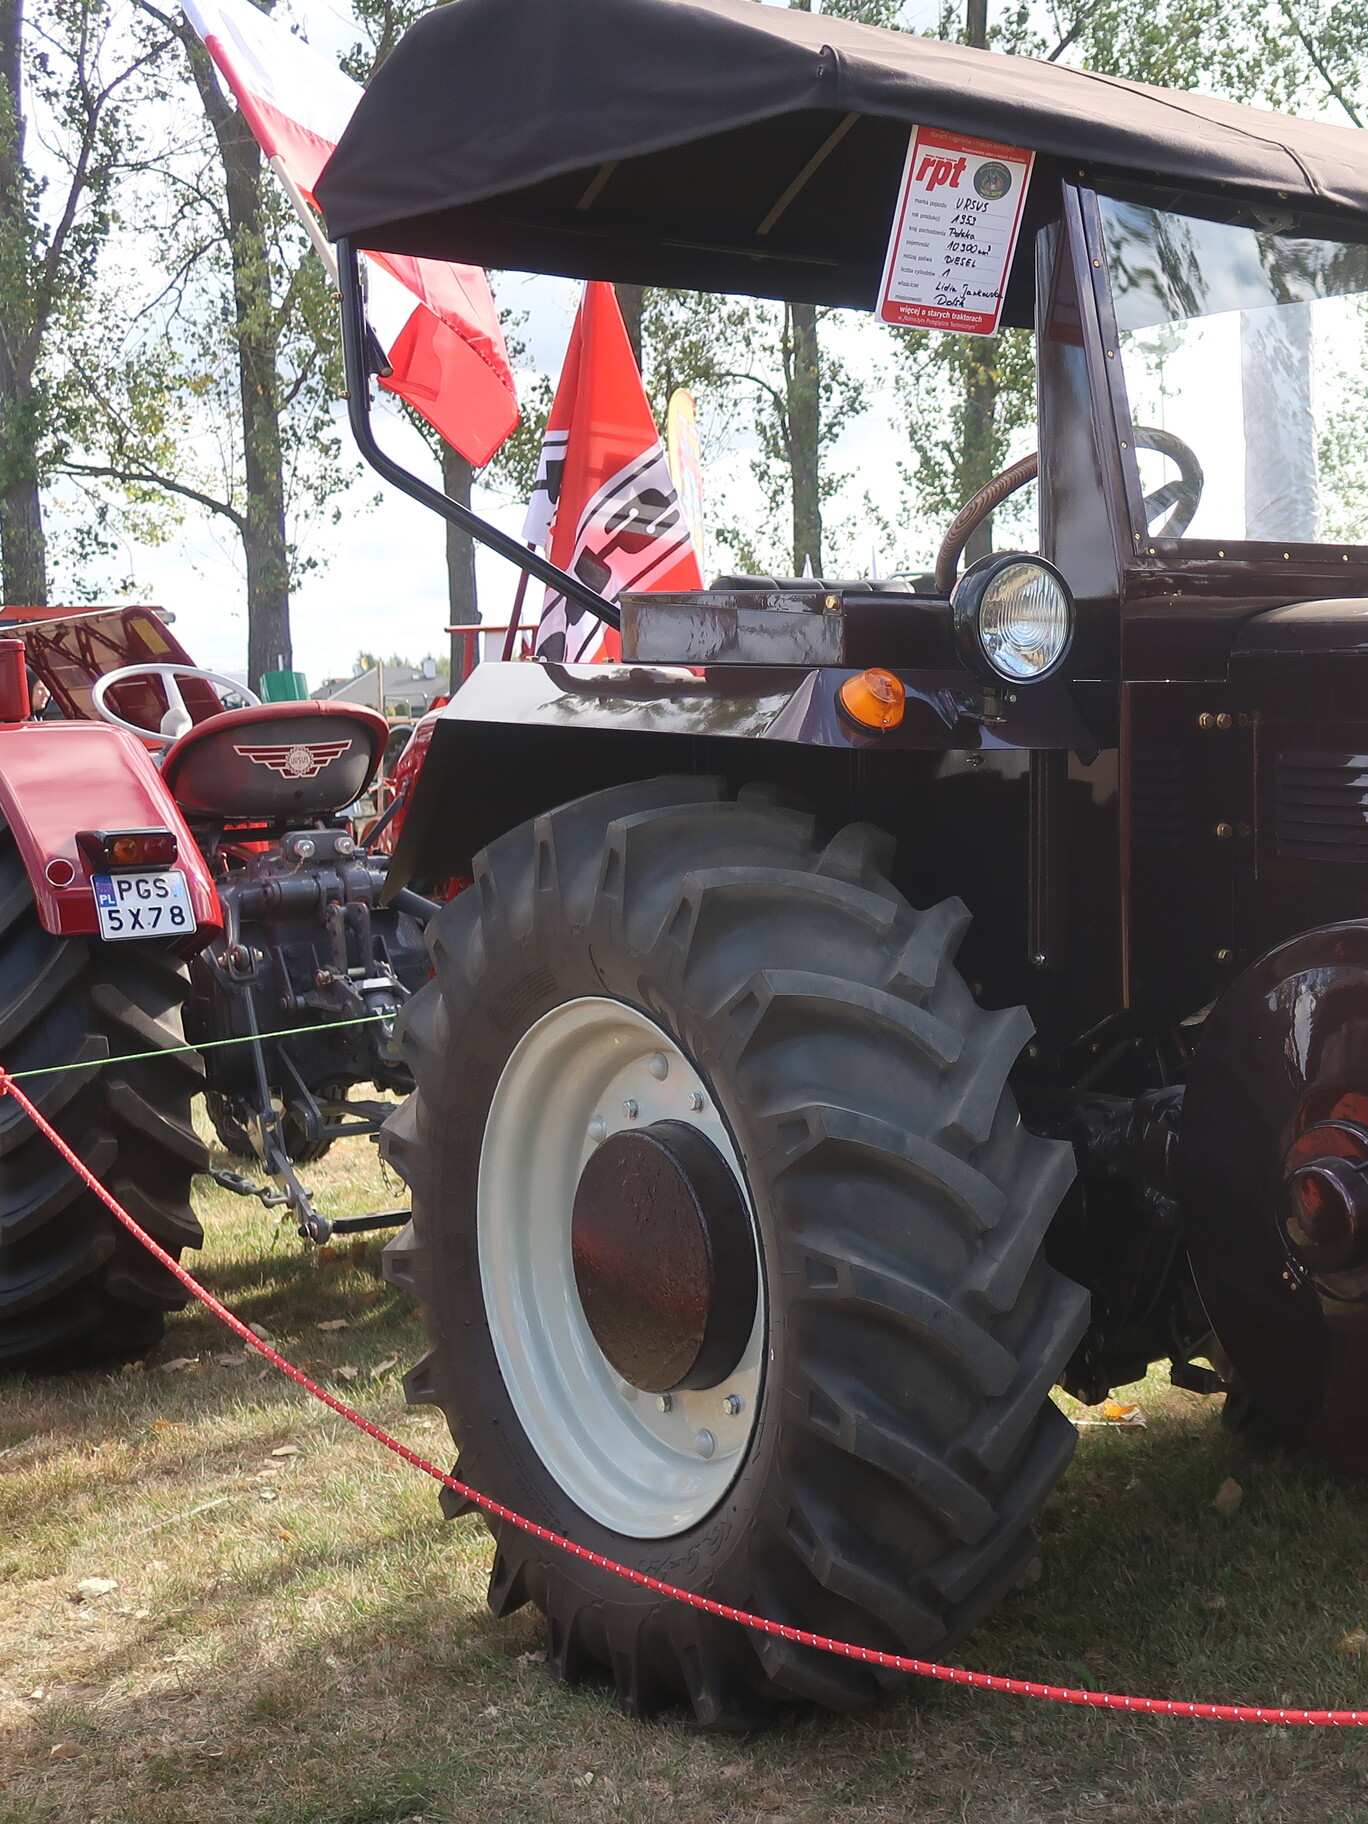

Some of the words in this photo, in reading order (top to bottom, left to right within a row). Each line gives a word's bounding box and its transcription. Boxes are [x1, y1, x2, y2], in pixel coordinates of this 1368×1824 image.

[915, 157, 967, 191] rpt
[915, 198, 928, 206] marka
[929, 200, 947, 209] pojazdu
[920, 213, 941, 222] produkcji
[951, 215, 977, 226] 1953
[918, 227, 946, 237] pochodzenia
[949, 227, 975, 240] Polska
[906, 240, 930, 249] pojemność
[903, 253, 917, 262] rodzaj
[918, 255, 932, 263] paliwa
[944, 255, 976, 268] DIESEL
[900, 266, 913, 274] liczba
[914, 267, 935, 277] cylindrów
[942, 268, 951, 277] 1
[897, 281, 919, 289] właściciel
[934, 294, 966, 308] Dolsk
[899, 305, 920, 316] więcej
[927, 310, 950, 319] starych
[951, 312, 983, 323] traktorach
[117, 878, 169, 901] PGS
[99, 894, 116, 905] PL
[108, 905, 186, 931] 5X78
